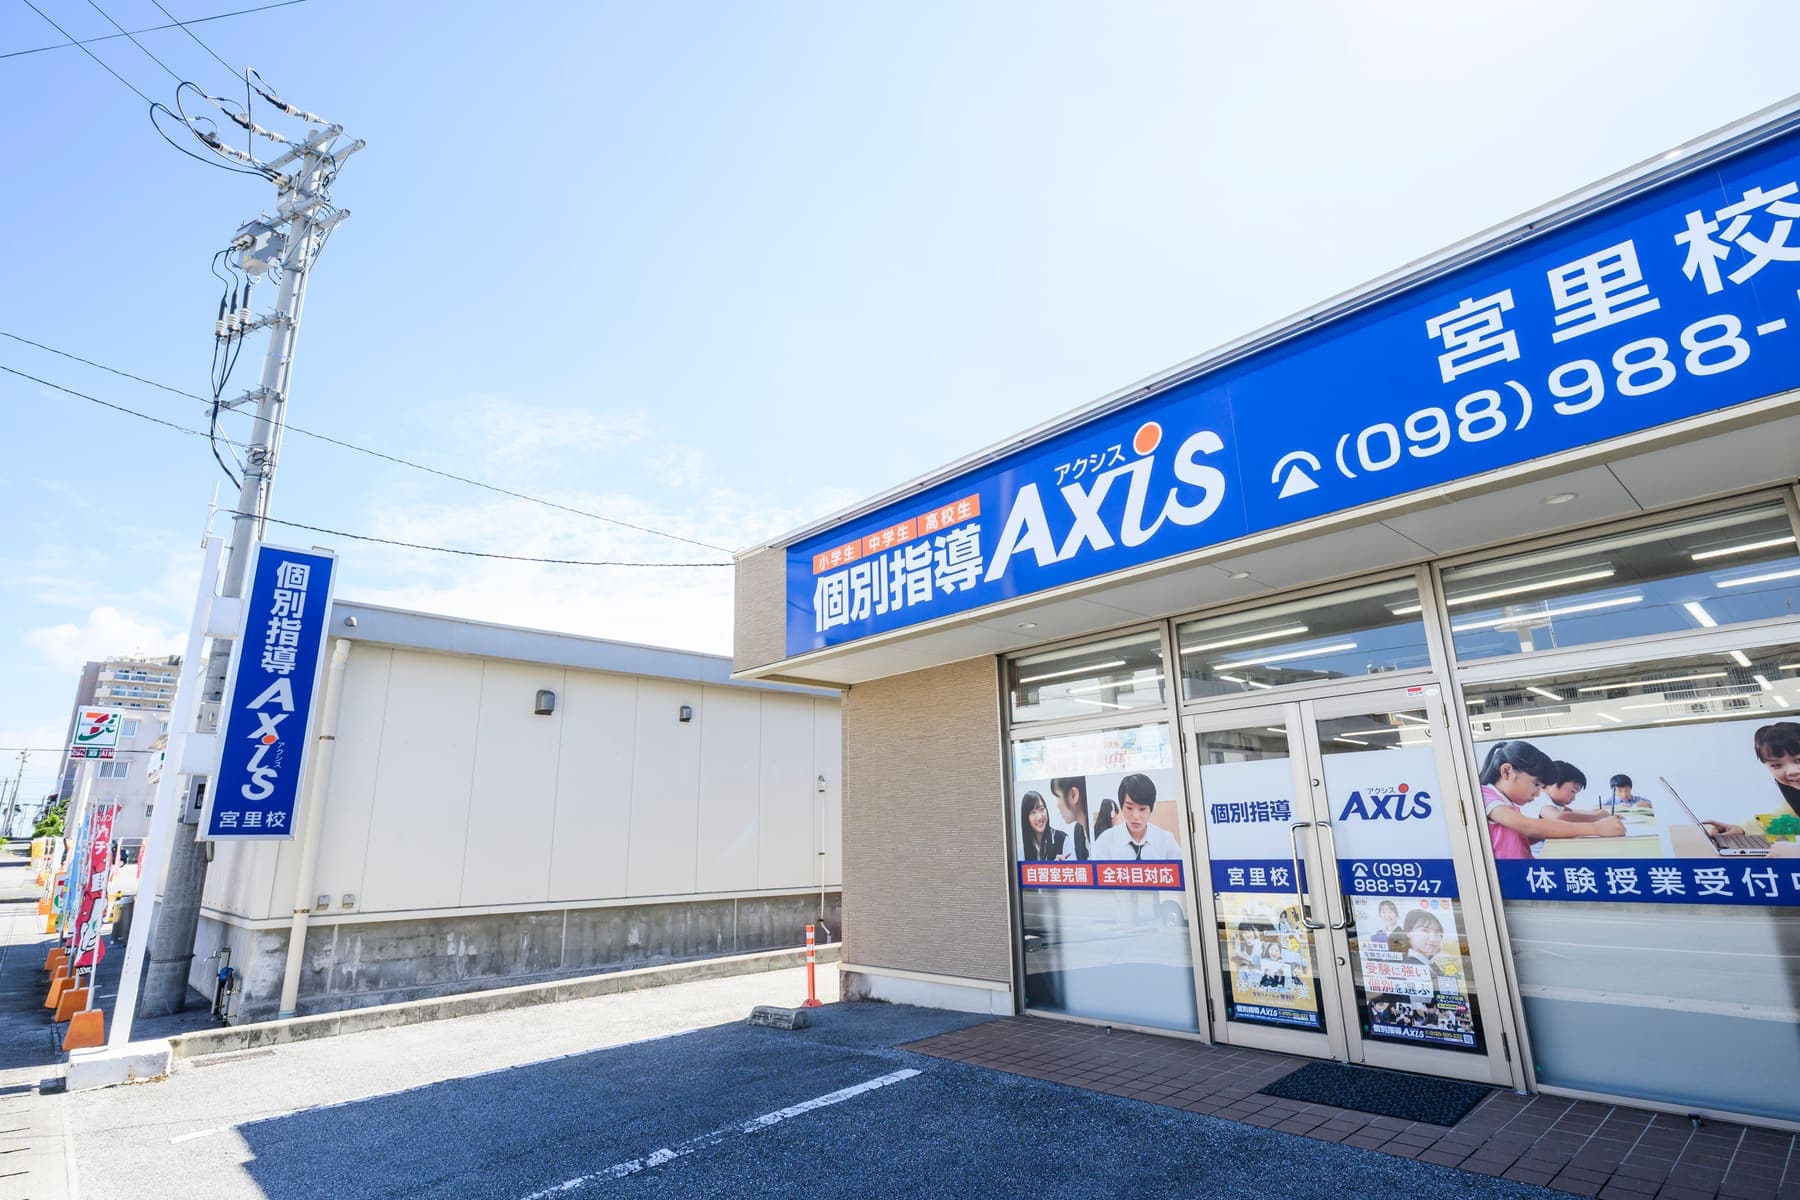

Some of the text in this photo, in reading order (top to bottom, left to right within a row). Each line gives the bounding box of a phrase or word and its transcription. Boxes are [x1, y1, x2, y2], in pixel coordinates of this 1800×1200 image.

[1426, 181, 1800, 384] 宮里校
[1336, 289, 1800, 479] (098)988-
[1054, 443, 1125, 485] アクシス
[819, 503, 972, 571] 小学生 中学生 高校生
[813, 523, 983, 632] 個別指導
[261, 560, 311, 675] 個別指導
[101, 748, 114, 757] ATM
[273, 742, 284, 769] アクシス
[1367, 786, 1396, 795] アクシス
[219, 810, 287, 829] 宮里校
[1211, 800, 1292, 824] 個別指導
[1026, 867, 1174, 884] 自習室完備 全科目対応
[1227, 867, 1290, 888] 宮里校
[1373, 862, 1422, 878] (098)
[1354, 879, 1442, 894] 988-5747
[1526, 867, 1800, 898] 体験授業受付
[1366, 962, 1428, 978] 受験に強い
[1368, 979, 1431, 995] 個別を選ぶ
